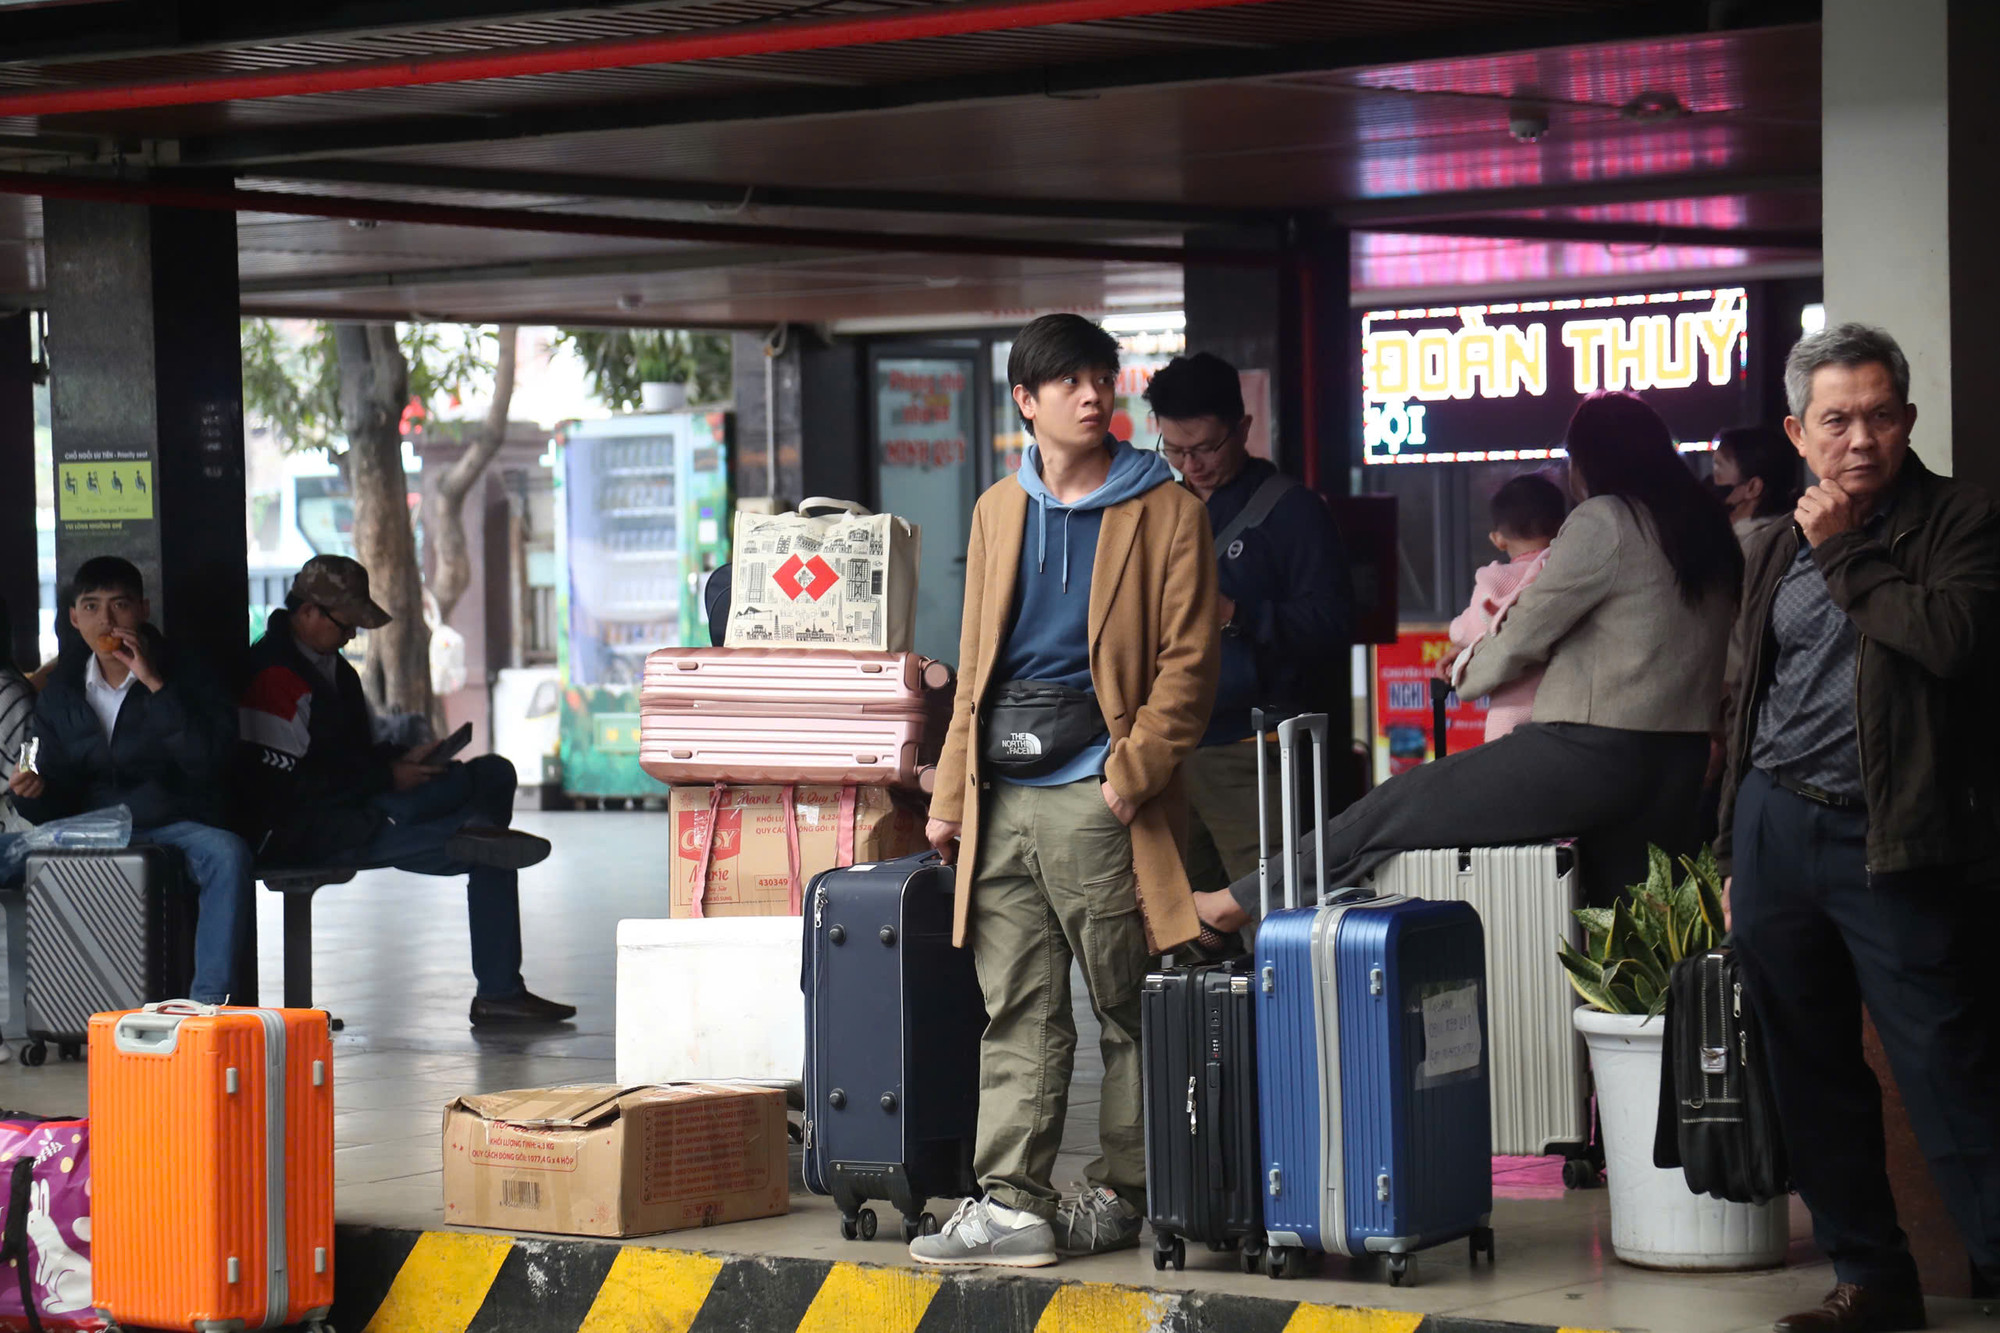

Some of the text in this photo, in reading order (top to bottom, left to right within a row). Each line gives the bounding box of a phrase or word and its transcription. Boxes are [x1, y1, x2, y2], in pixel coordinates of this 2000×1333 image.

[1369, 312, 1547, 401] ĐOÀN
[1010, 732, 1026, 740] THE
[1001, 740, 1026, 748] NORTH
[737, 790, 770, 806] Marie
[807, 792, 829, 805] Quy
[756, 827, 771, 835] QUY
